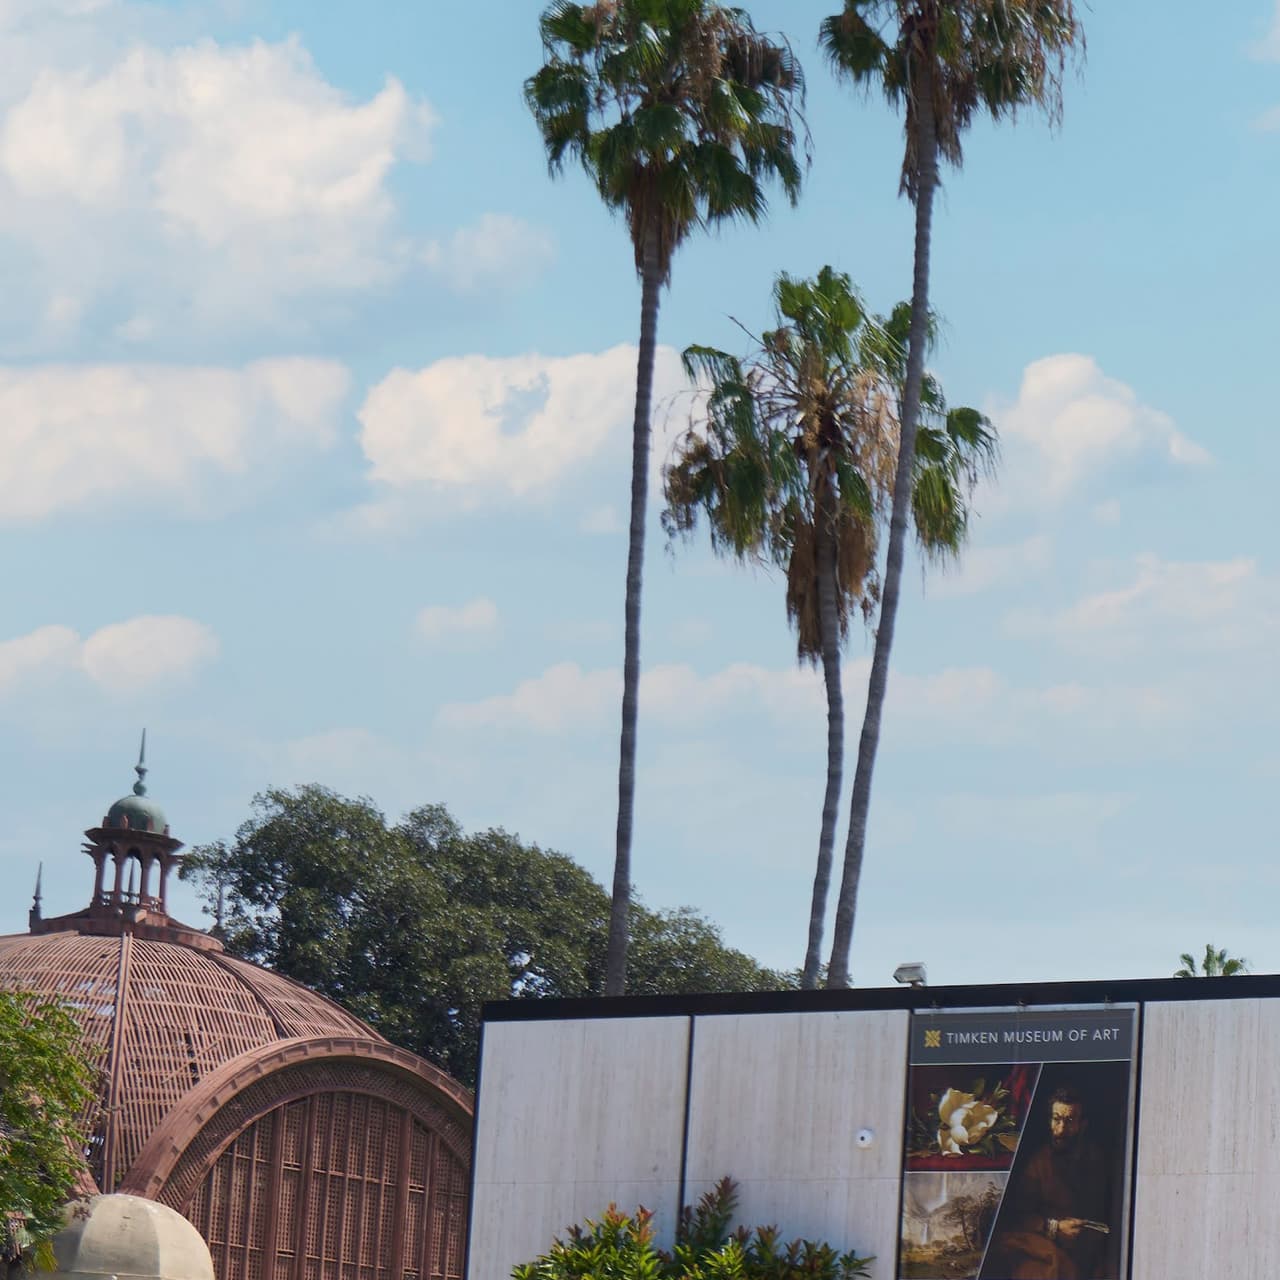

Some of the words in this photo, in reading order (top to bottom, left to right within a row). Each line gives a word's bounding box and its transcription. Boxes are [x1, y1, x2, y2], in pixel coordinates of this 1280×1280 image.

[946, 1032, 998, 1044] TIMKEN
[1003, 1030, 1063, 1043] MUSEUM
[1068, 1029, 1088, 1042] OF
[1092, 1028, 1121, 1041] ART
